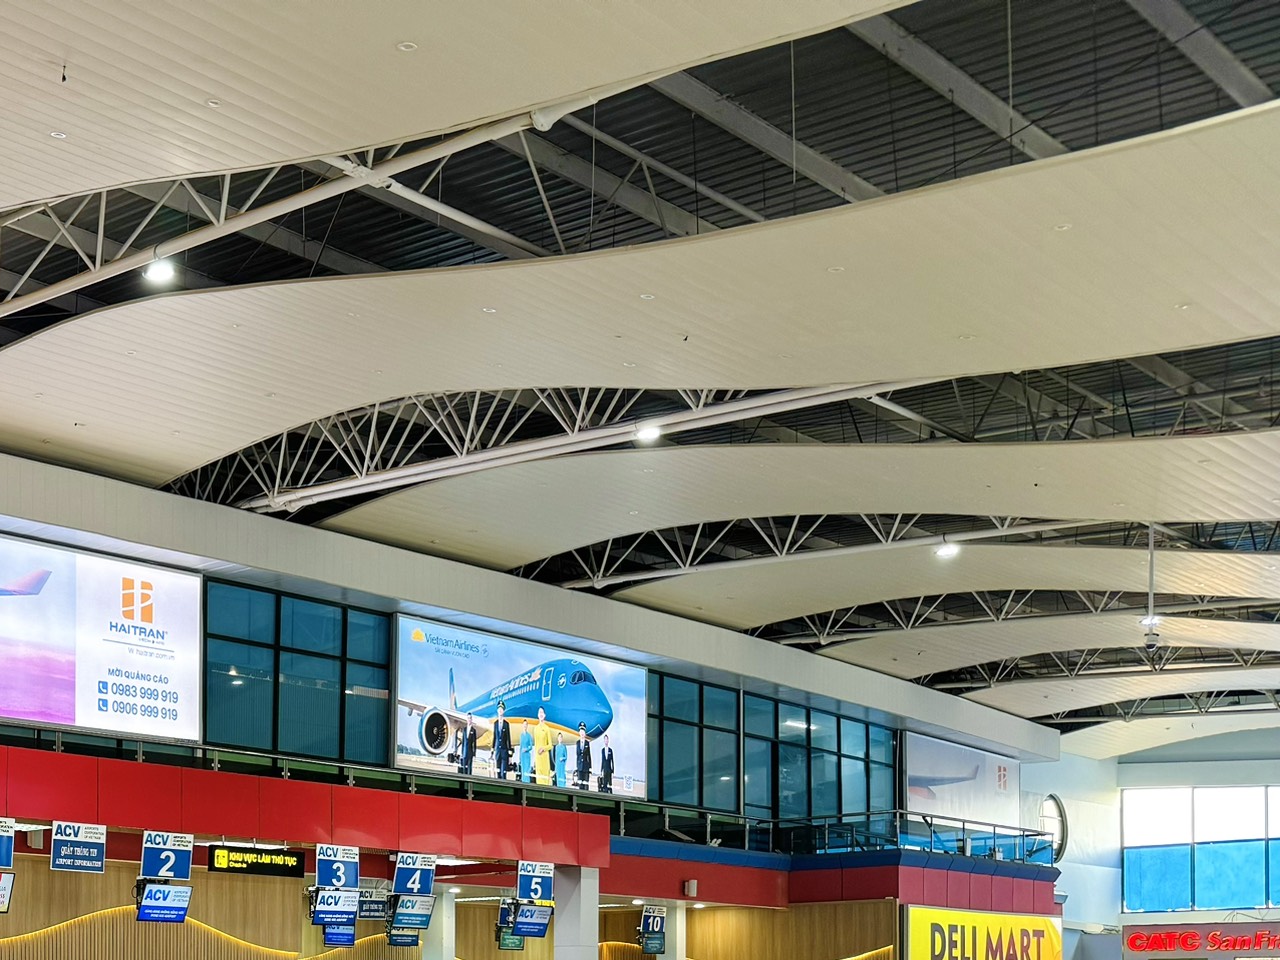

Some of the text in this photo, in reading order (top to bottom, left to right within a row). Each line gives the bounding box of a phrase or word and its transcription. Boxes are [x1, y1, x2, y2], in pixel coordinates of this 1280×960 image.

[109, 621, 166, 640] HAITRAN
[424, 632, 454, 648] Vietnam
[454, 639, 480, 653] Airlines
[108, 667, 123, 678] MỜI
[152, 673, 170, 684] CÁO
[111, 682, 178, 704] 0983 999 919
[112, 700, 178, 720] 0906 999 919
[55, 824, 80, 838] ACV
[144, 833, 170, 846] ACV
[318, 846, 338, 858] ACV
[158, 850, 176, 877] 2
[398, 855, 418, 866] ACV
[520, 862, 537, 873] ACV
[332, 862, 346, 886] 3
[406, 870, 421, 893] 4
[144, 889, 171, 901] ACV
[359, 890, 373, 898] ACV
[530, 877, 542, 899] 5
[318, 895, 341, 906] ACV
[398, 899, 417, 909] ACV
[518, 909, 536, 918] ACV
[648, 916, 661, 931] 10
[1206, 930, 1253, 950] San
[1254, 930, 1280, 950] Fr
